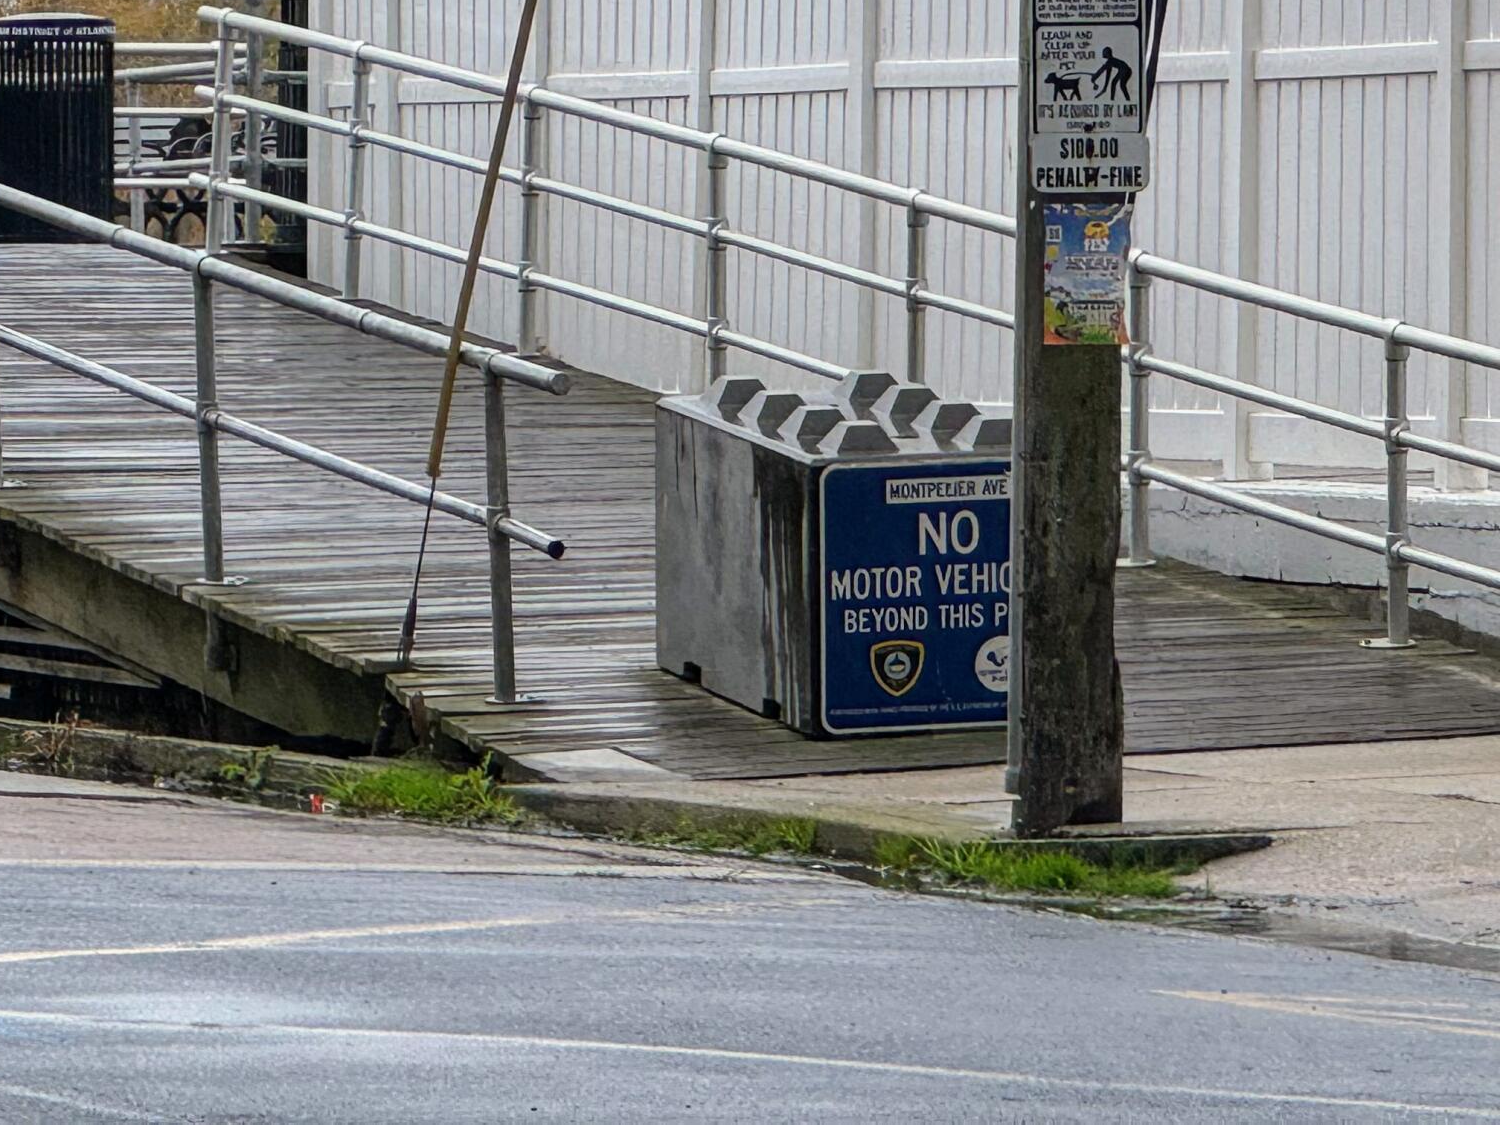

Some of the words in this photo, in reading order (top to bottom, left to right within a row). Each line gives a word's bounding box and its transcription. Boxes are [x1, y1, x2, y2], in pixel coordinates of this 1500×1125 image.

[1075, 30, 1093, 40] AND
[1103, 103, 1115, 118] BY
[889, 481, 976, 501] MONTPELIER
[982, 478, 1008, 496] AVE
[918, 509, 980, 556] NO
[831, 565, 922, 601] MOTOR
[844, 607, 929, 634] BEYOND
[938, 602, 985, 630] THIS
